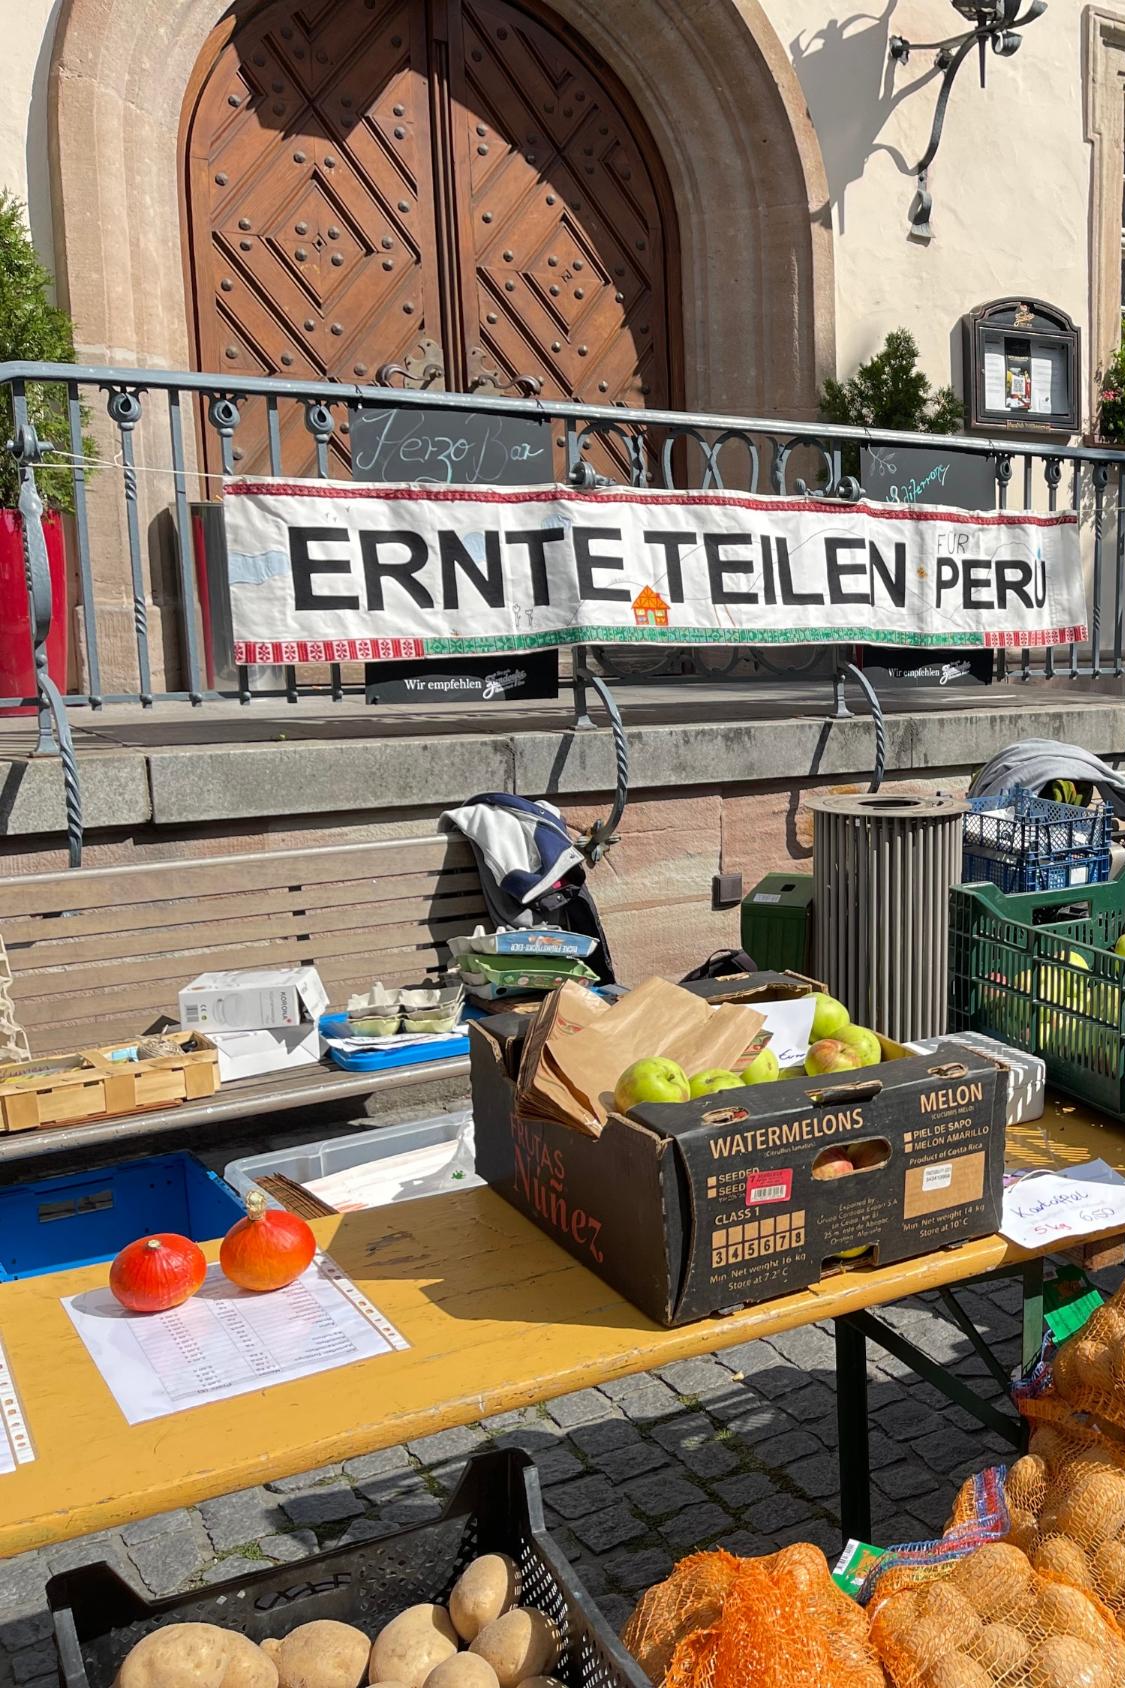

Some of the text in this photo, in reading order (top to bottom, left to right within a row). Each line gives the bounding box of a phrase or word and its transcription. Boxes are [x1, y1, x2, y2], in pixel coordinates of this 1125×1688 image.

[465, 414, 544, 483] Bar
[288, 526, 906, 611] ERNTE TEILEN
[936, 557, 1046, 609] PERU
[404, 679, 426, 690] Wir
[428, 679, 482, 692] empfehlen
[920, 1082, 983, 1114] MELON
[709, 1108, 864, 1159] WATERMELONS
[913, 1118, 972, 1140] PIEL DE SAPO
[914, 1126, 989, 1150] MELON AMARILLO
[509, 1112, 565, 1179] FRUTAS
[909, 1152, 938, 1165] Product
[939, 1150, 947, 1158] of
[947, 1145, 967, 1156] Costa
[715, 1207, 760, 1225] CLASS 1
[1010, 1190, 1089, 1219] Kartoffel
[921, 1219, 935, 1227] Net
[936, 1209, 962, 1222] weight
[919, 1228, 940, 1238] Store
[715, 1231, 801, 1264] 3 4 5 6 7 8
[731, 1268, 747, 1278] Net
[749, 1259, 779, 1273] weight
[728, 1278, 751, 1291] Store
[753, 1276, 762, 1284] at
